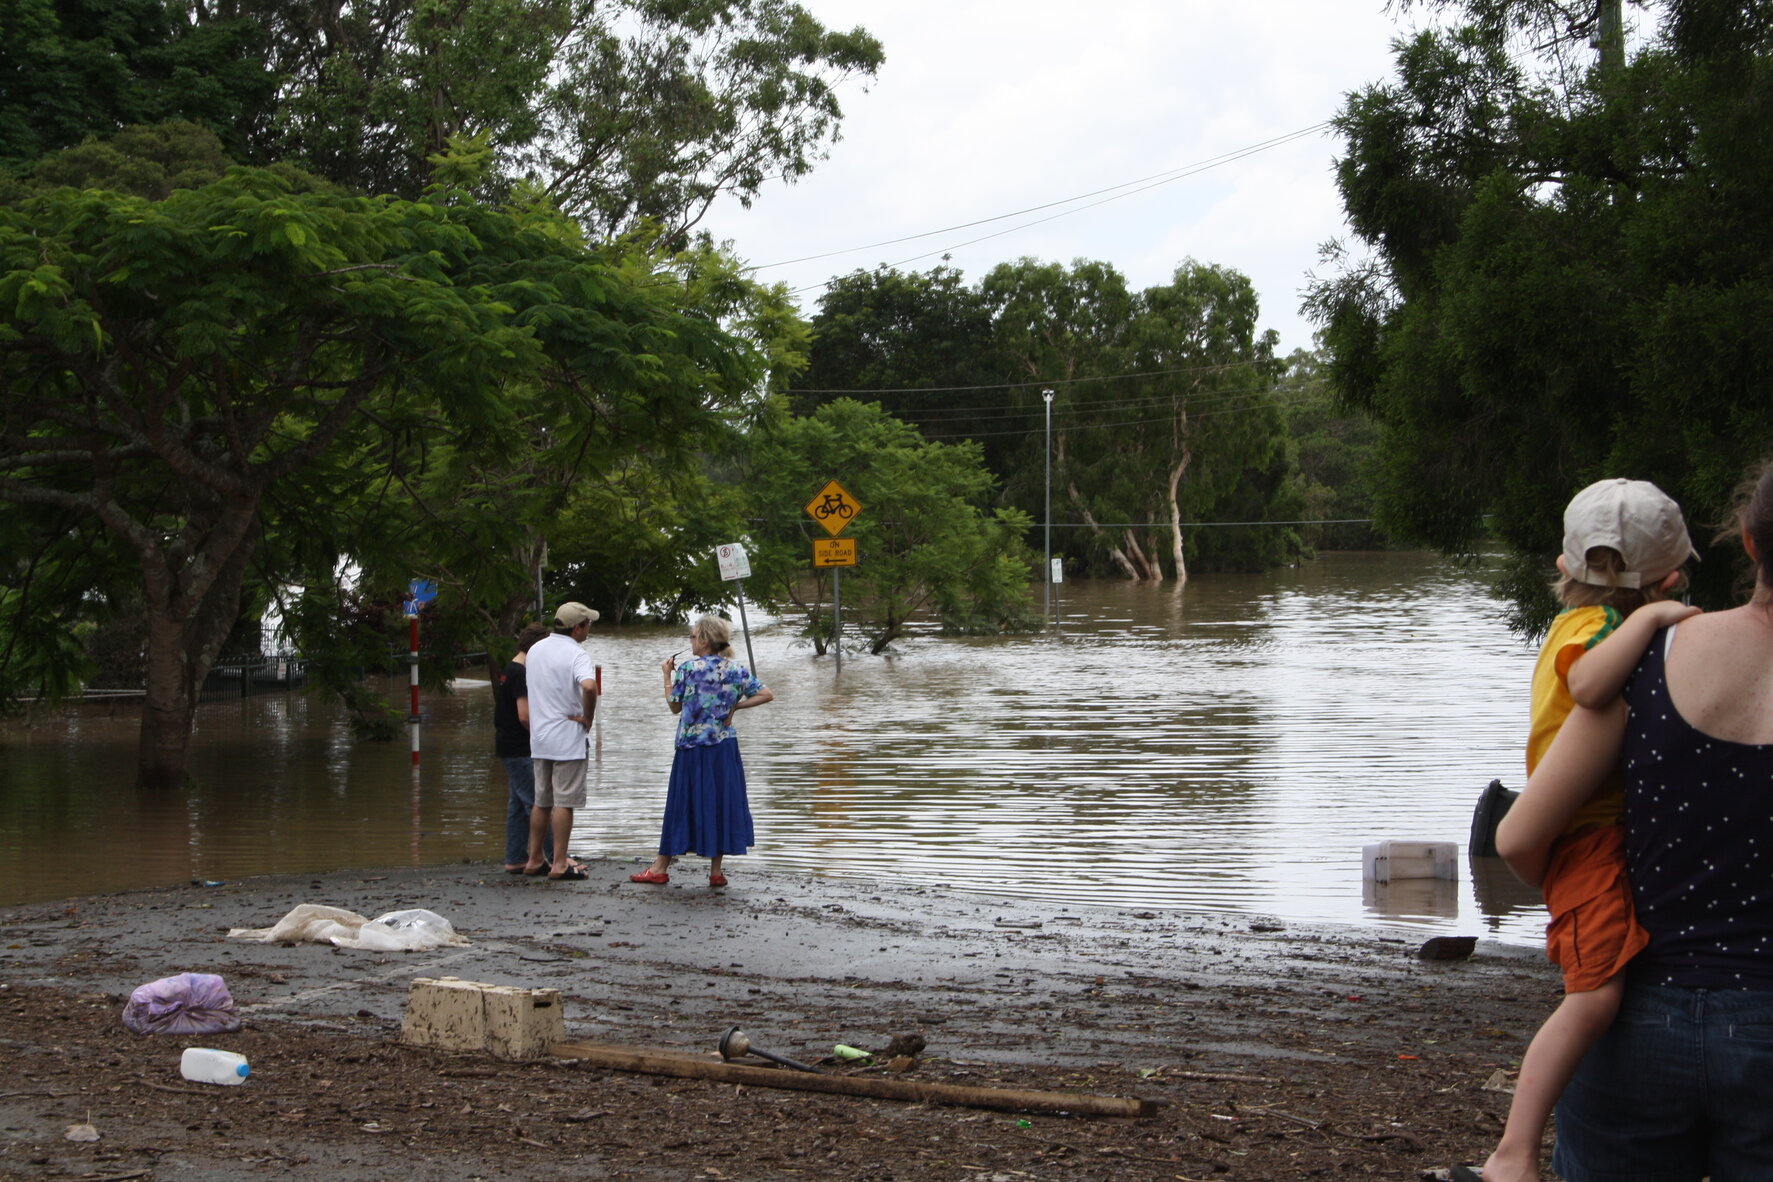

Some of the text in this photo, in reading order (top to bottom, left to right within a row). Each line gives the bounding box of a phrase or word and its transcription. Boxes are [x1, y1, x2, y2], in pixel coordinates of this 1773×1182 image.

[829, 541, 840, 549] ON
[818, 549, 852, 558] SIDE ROAD
